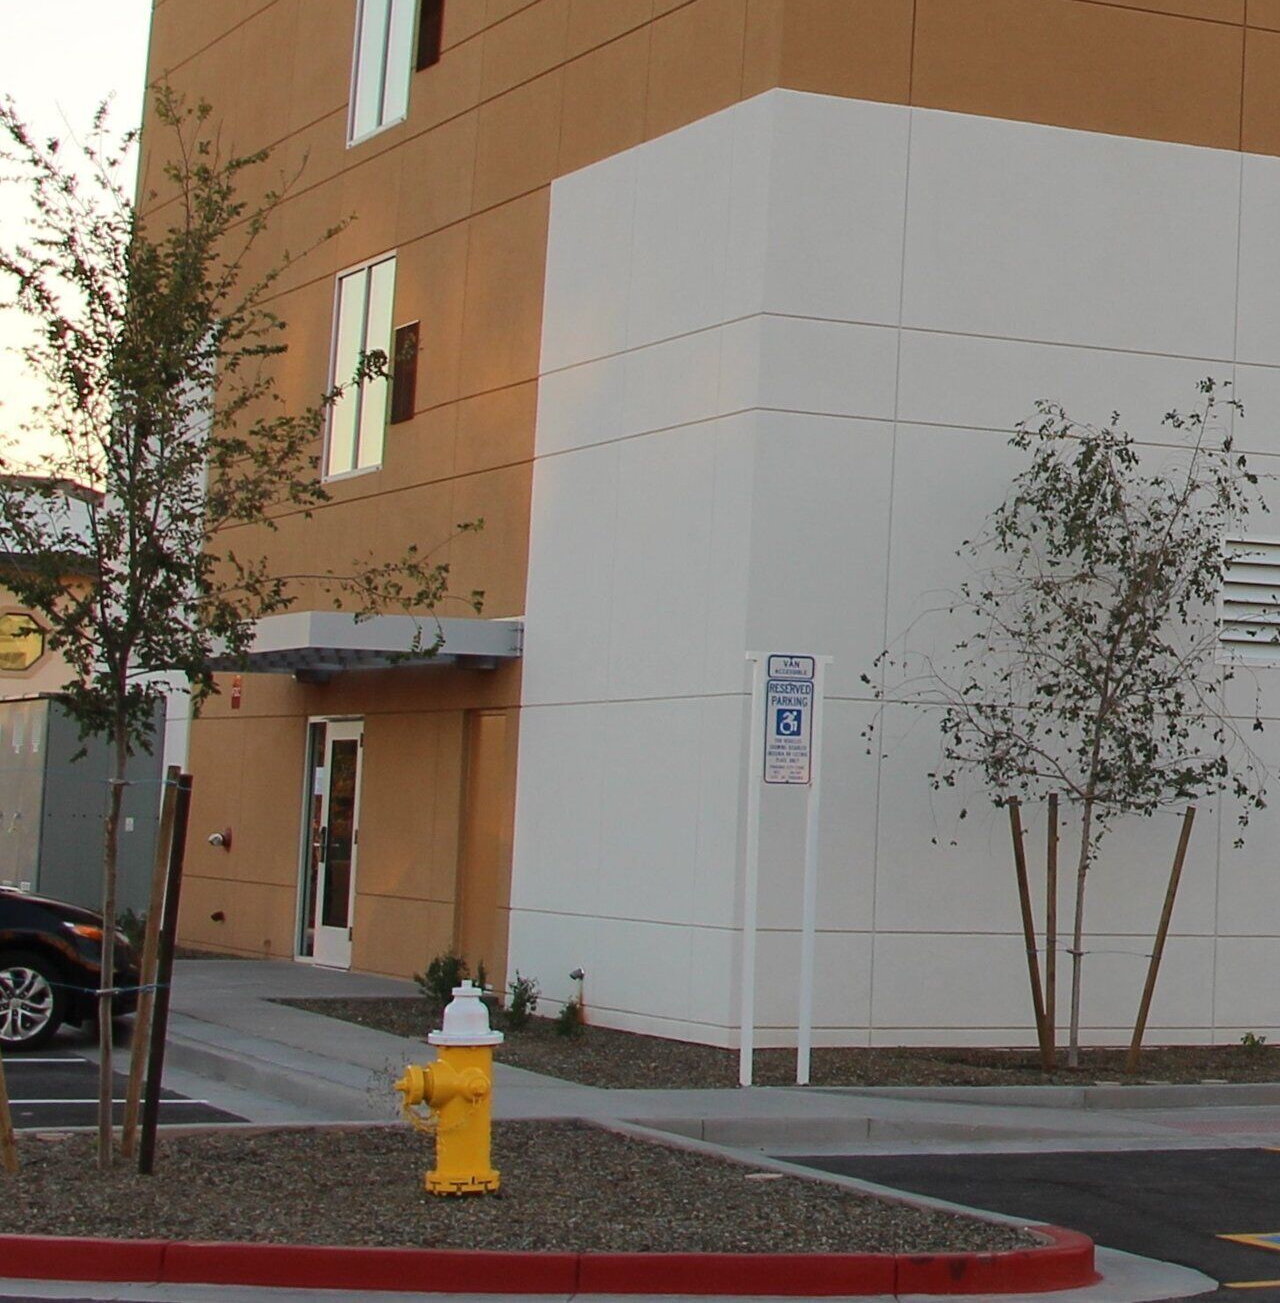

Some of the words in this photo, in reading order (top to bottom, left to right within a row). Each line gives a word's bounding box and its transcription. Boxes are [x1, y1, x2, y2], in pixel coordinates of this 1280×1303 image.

[783, 659, 800, 668] VAN
[769, 683, 811, 695] RESERVED
[771, 695, 808, 707] PARKING
